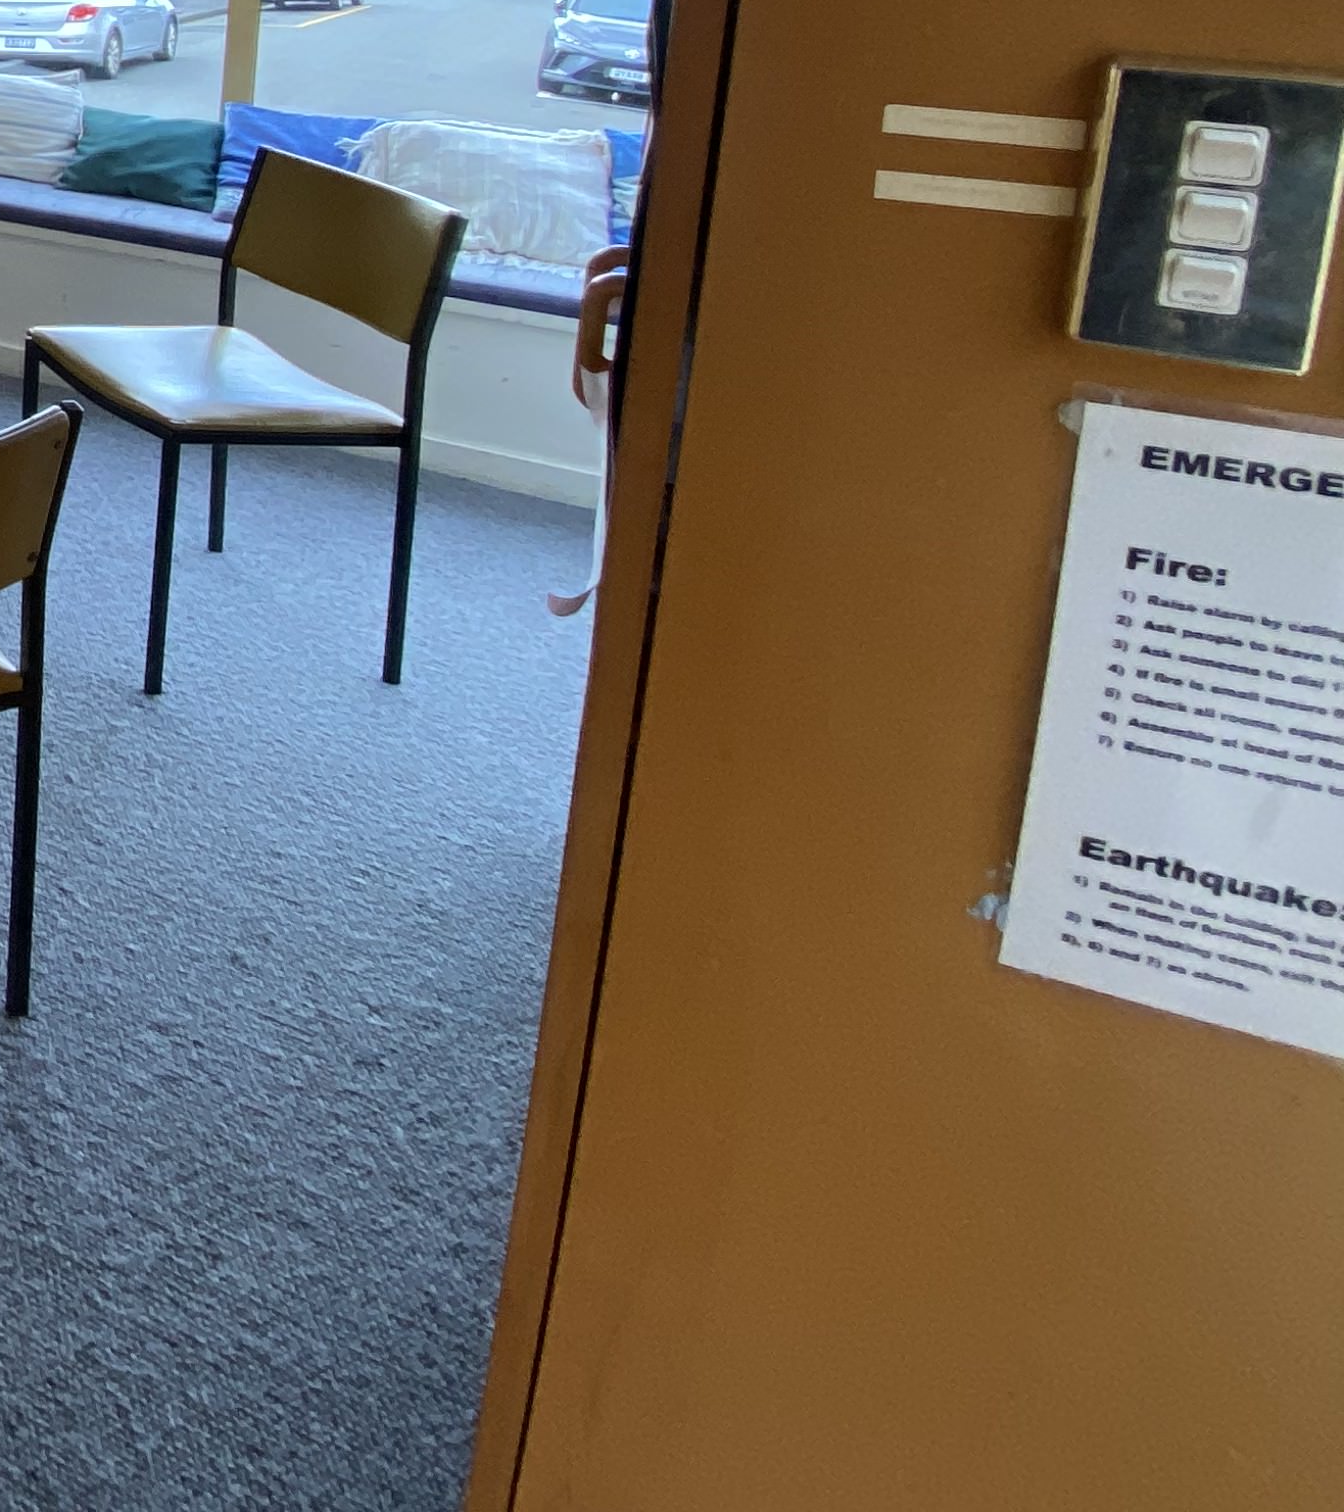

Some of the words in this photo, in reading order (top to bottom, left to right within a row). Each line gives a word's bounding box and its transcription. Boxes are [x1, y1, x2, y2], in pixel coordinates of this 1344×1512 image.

[1141, 445, 1344, 498] EMERGE
[1125, 546, 1228, 586] Fire:
[1115, 614, 1133, 628] 2)
[1143, 620, 1177, 635] Ask
[1182, 629, 1244, 647] people
[1249, 640, 1269, 652] to
[1273, 644, 1324, 663] leave
[1260, 616, 1283, 630] by
[1112, 638, 1129, 653] 3)
[1139, 645, 1173, 659] Ask
[1178, 654, 1261, 676] someone
[1266, 669, 1286, 681] to
[1131, 693, 1188, 713] Check
[1193, 707, 1216, 718] all
[1210, 686, 1260, 702] small
[1128, 718, 1214, 743] Assemble
[1123, 740, 1186, 762] Ensure
[1079, 835, 1344, 921] Earthquake
